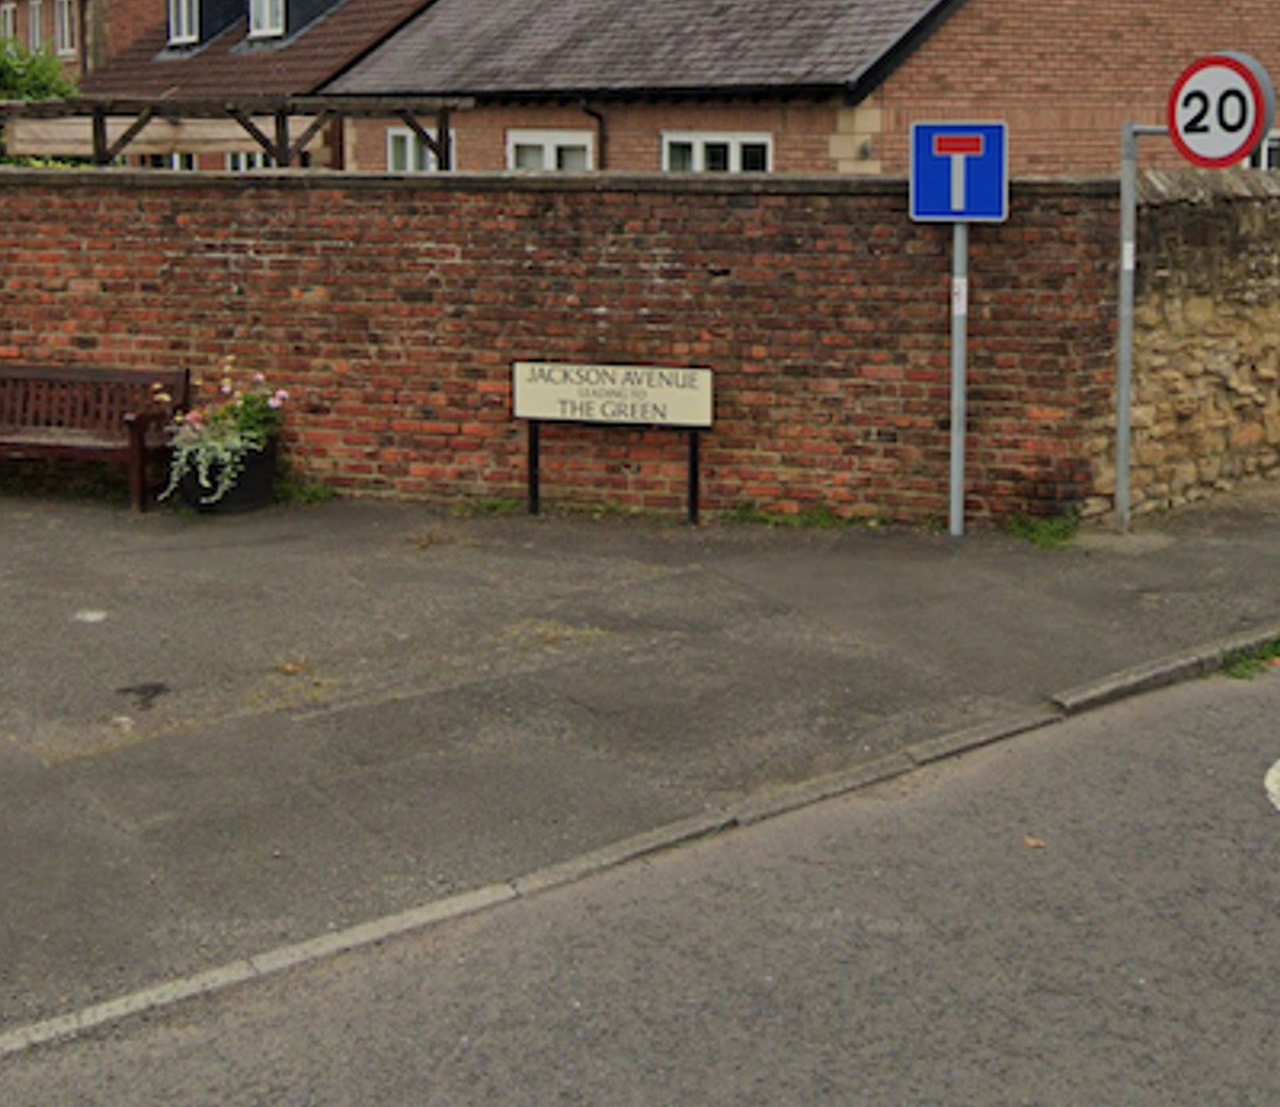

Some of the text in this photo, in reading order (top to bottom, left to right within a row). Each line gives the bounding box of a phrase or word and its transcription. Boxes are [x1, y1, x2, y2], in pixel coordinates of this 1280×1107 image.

[1182, 88, 1248, 133] 20
[526, 367, 698, 389] JACKSON AVENUE
[558, 399, 667, 420] THE GREEN
